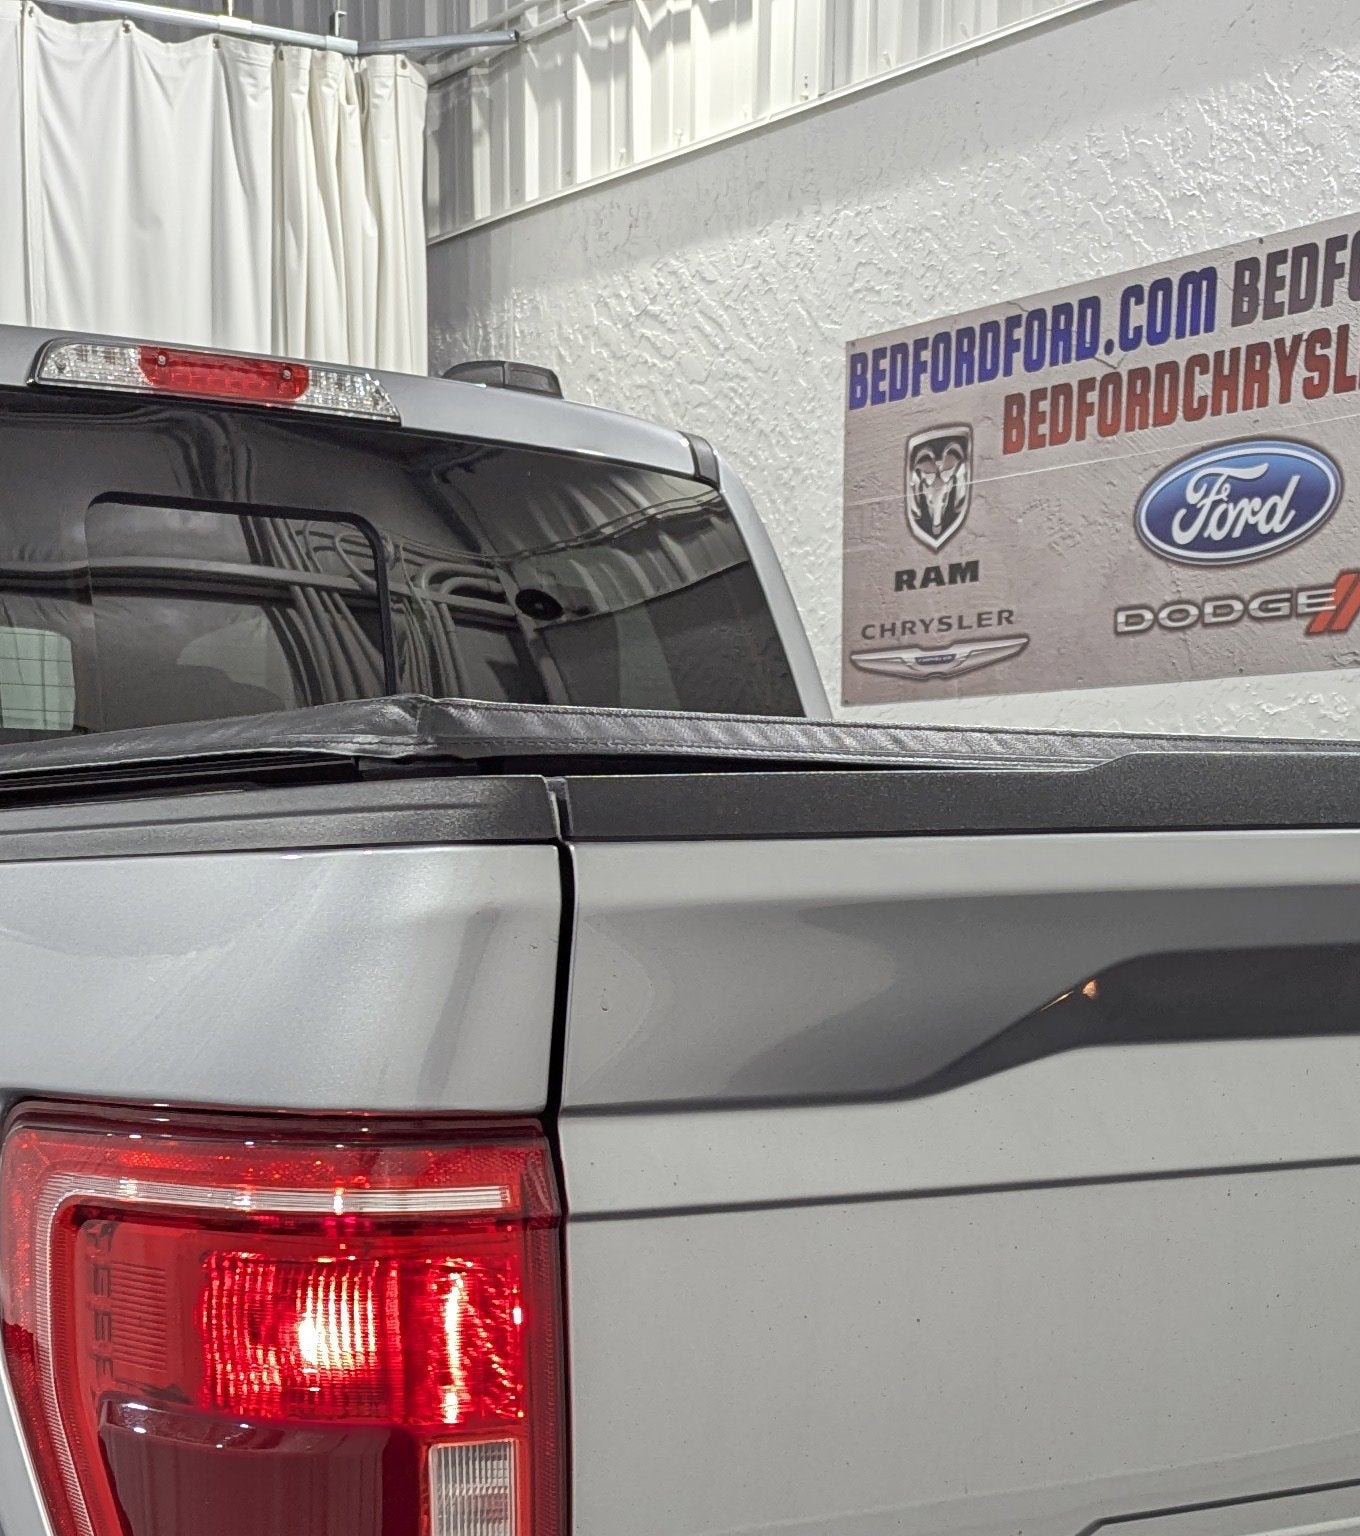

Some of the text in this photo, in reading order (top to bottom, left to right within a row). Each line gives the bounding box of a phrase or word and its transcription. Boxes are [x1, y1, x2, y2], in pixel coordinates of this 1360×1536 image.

[848, 265, 1218, 411] BEDFORDFORD.COM
[1171, 462, 1301, 545] Ford
[894, 560, 980, 592] RAM
[861, 609, 1015, 640] CHRYSLER
[1115, 583, 1337, 635] DODGE
